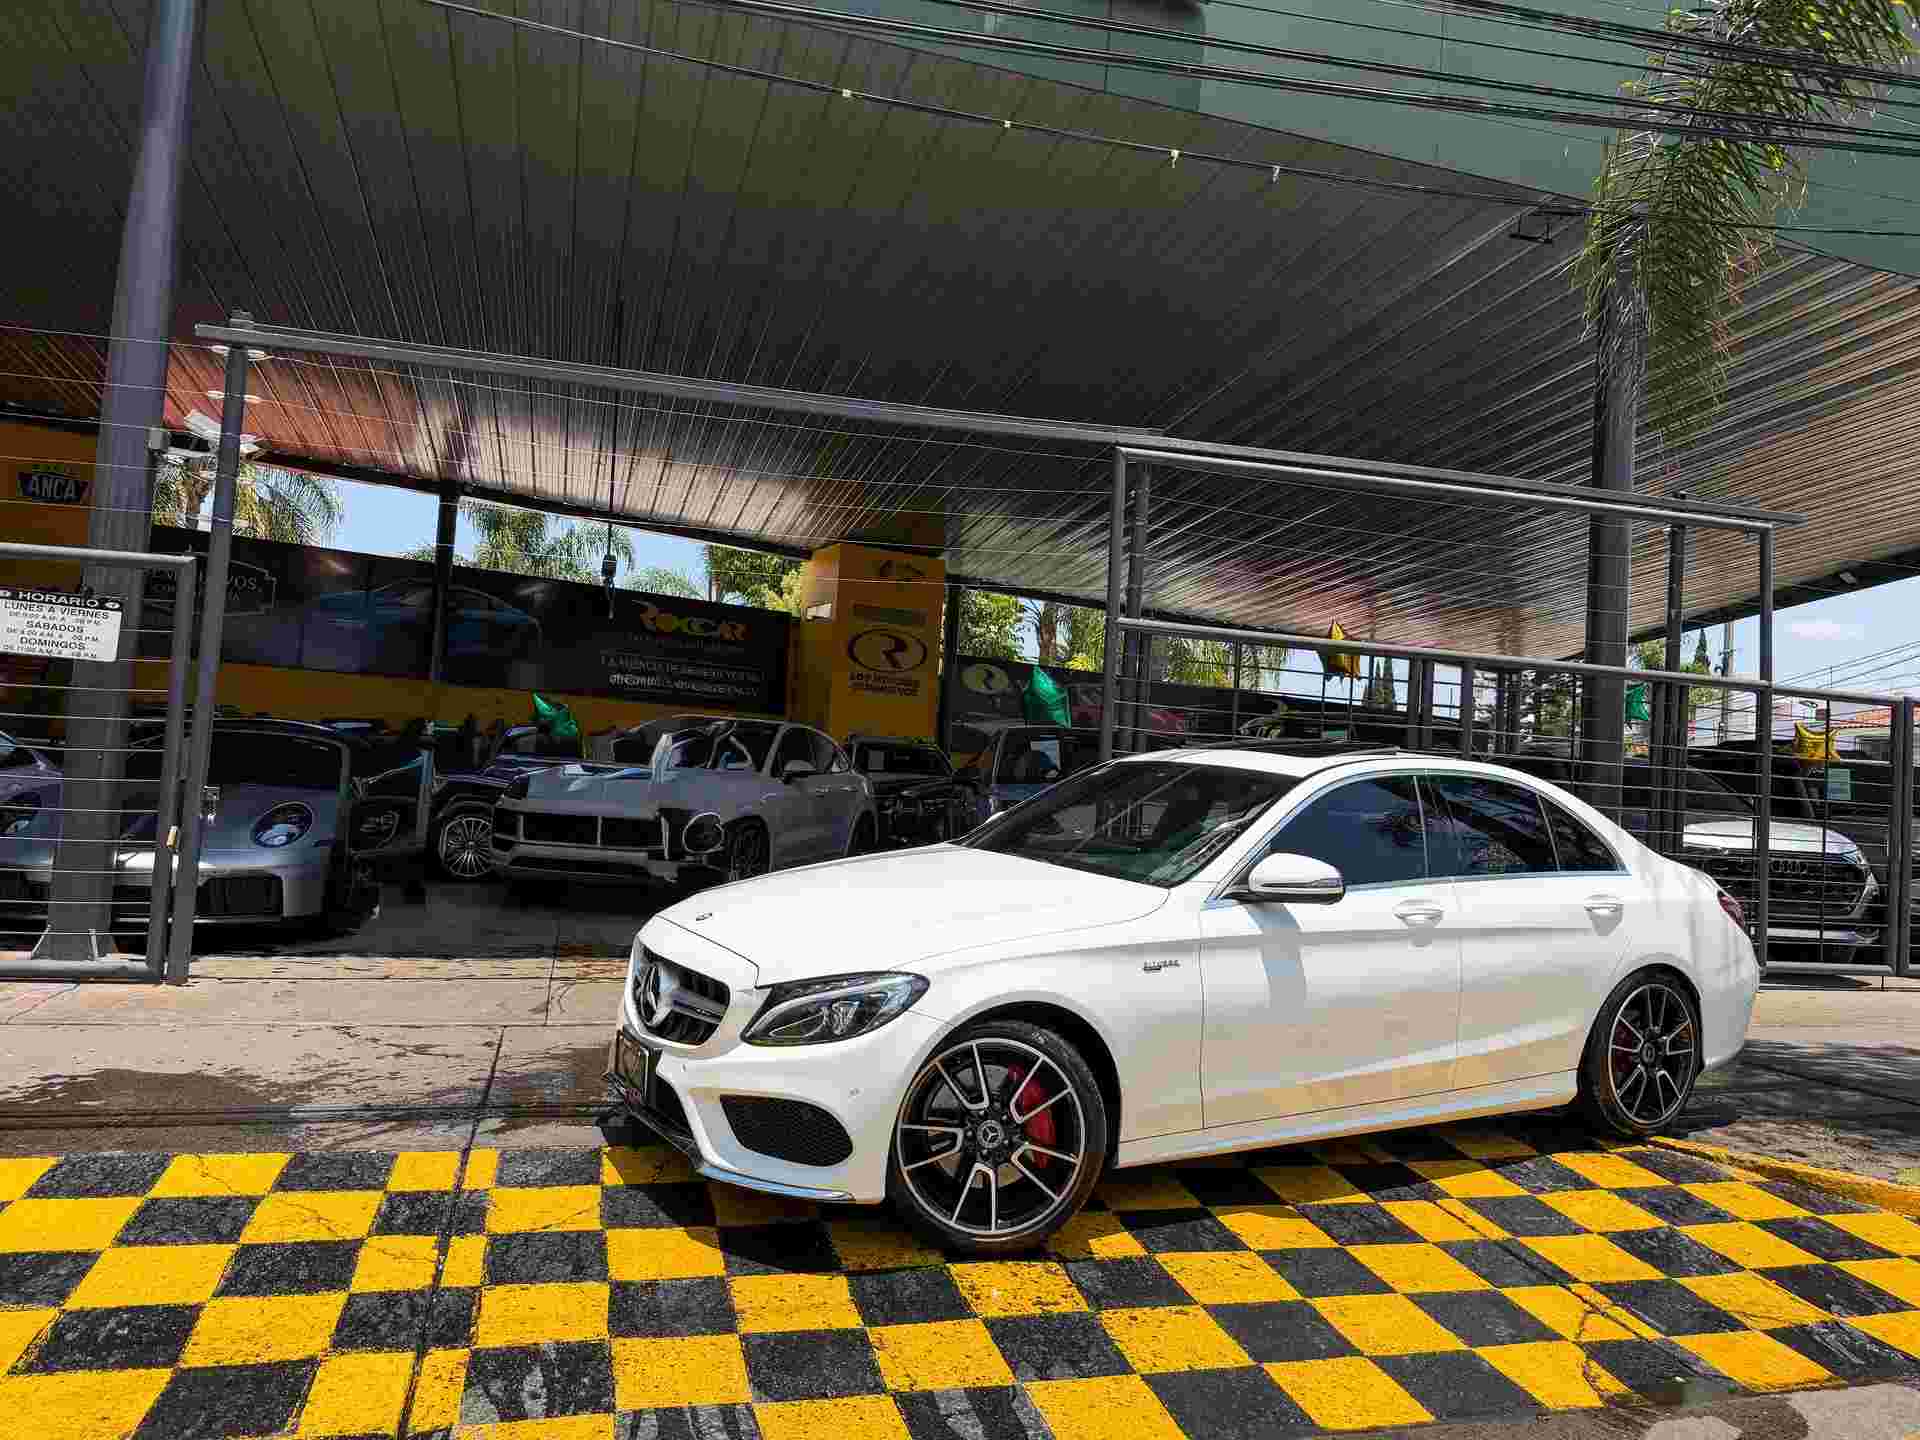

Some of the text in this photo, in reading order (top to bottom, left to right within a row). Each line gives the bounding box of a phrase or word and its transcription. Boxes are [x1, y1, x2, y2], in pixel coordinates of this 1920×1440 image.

[31, 475, 77, 498] ANCA
[18, 591, 100, 607] HORARIO
[4, 600, 110, 620] LUNES A VIERNES
[20, 636, 86, 650] DOMINGOS
